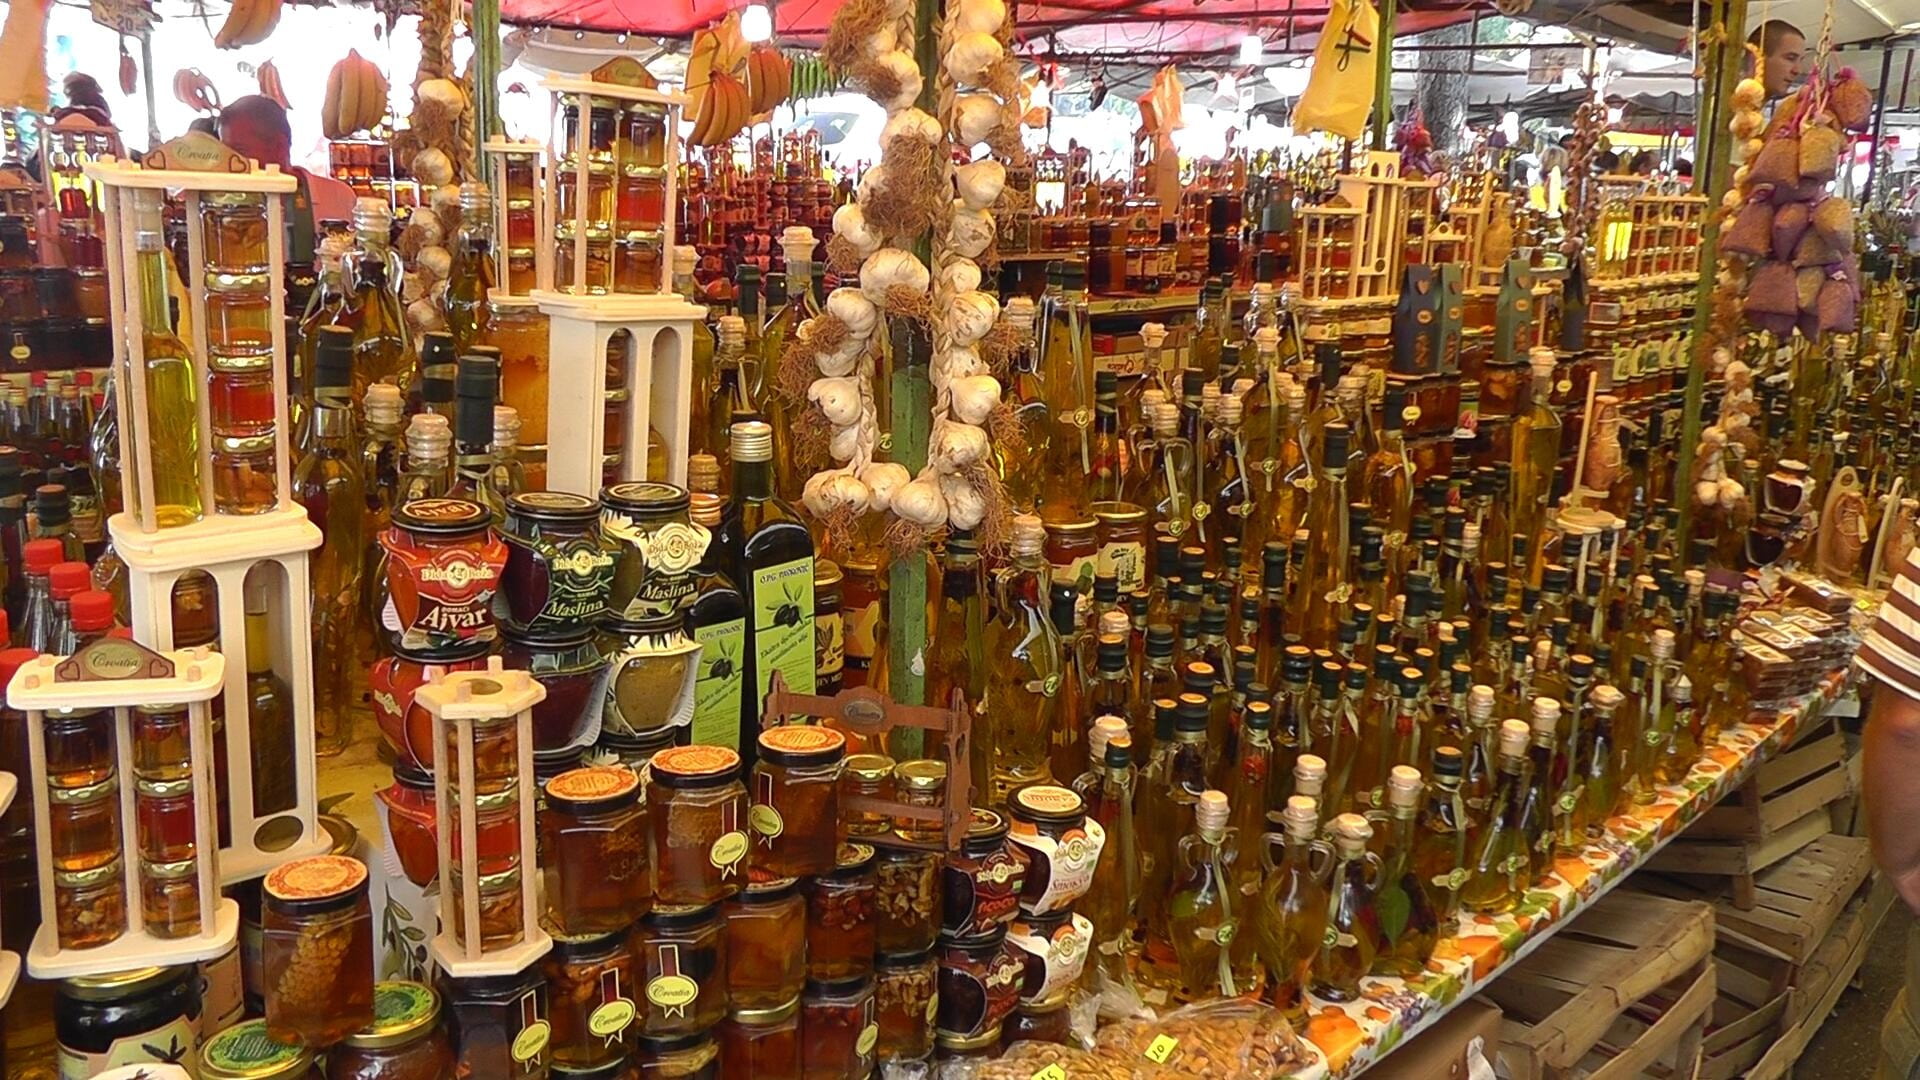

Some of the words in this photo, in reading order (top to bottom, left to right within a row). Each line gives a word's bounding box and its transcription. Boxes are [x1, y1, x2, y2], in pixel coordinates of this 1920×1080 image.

[174, 144, 221, 160] Croatia
[642, 582, 695, 600] Maslina
[547, 600, 604, 617] Maslina
[418, 606, 488, 631] Ajvar
[90, 651, 139, 668] Croatia
[651, 984, 691, 998] Croatia
[594, 1011, 629, 1029] Croatia
[518, 1033, 546, 1055] Croatia
[1152, 1044, 1165, 1059] 10
